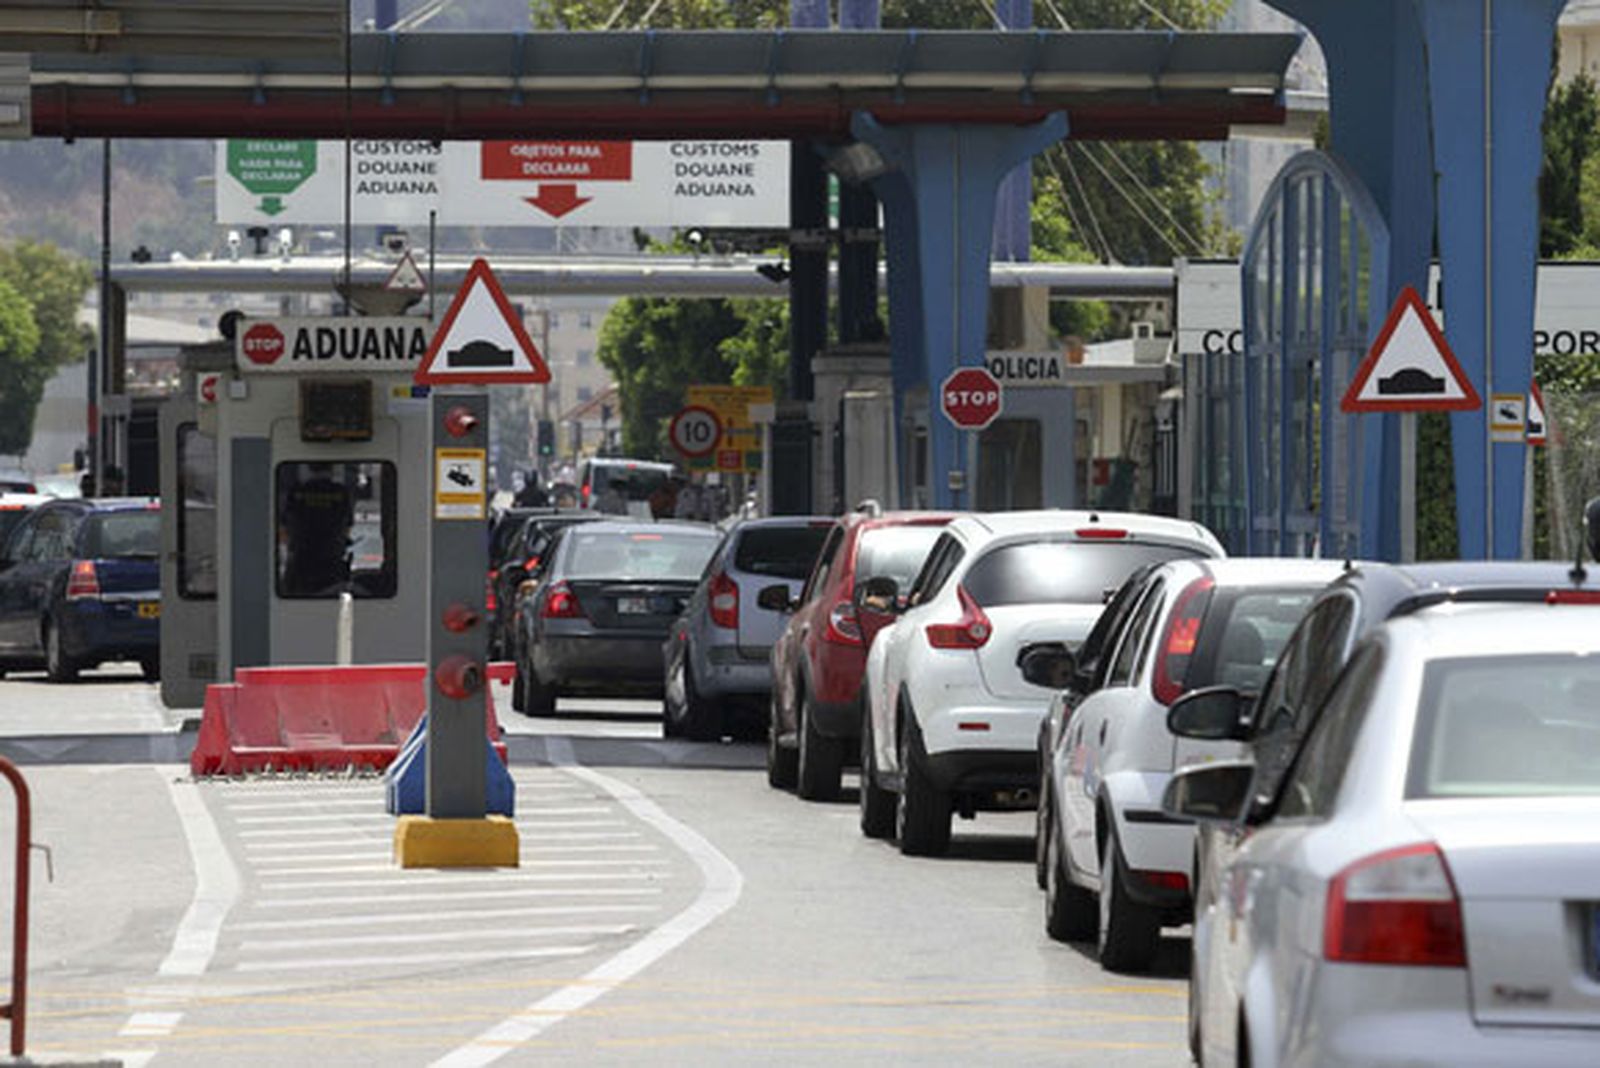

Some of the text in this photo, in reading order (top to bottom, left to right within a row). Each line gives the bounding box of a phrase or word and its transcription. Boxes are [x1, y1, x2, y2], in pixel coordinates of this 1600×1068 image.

[510, 144, 601, 158] OBJETOS PARA
[671, 143, 760, 156] CUSTOMS
[358, 161, 437, 175] DOUANE
[522, 162, 591, 175] DECLARAR
[675, 162, 755, 177] DOUANE
[357, 181, 438, 194] ADUANA
[675, 182, 756, 197] ADUANA
[245, 338, 283, 351] STOP
[292, 327, 427, 360] ADUANA
[985, 357, 1060, 379] OLICIA
[946, 391, 998, 407] STOP
[684, 420, 711, 442] 10
